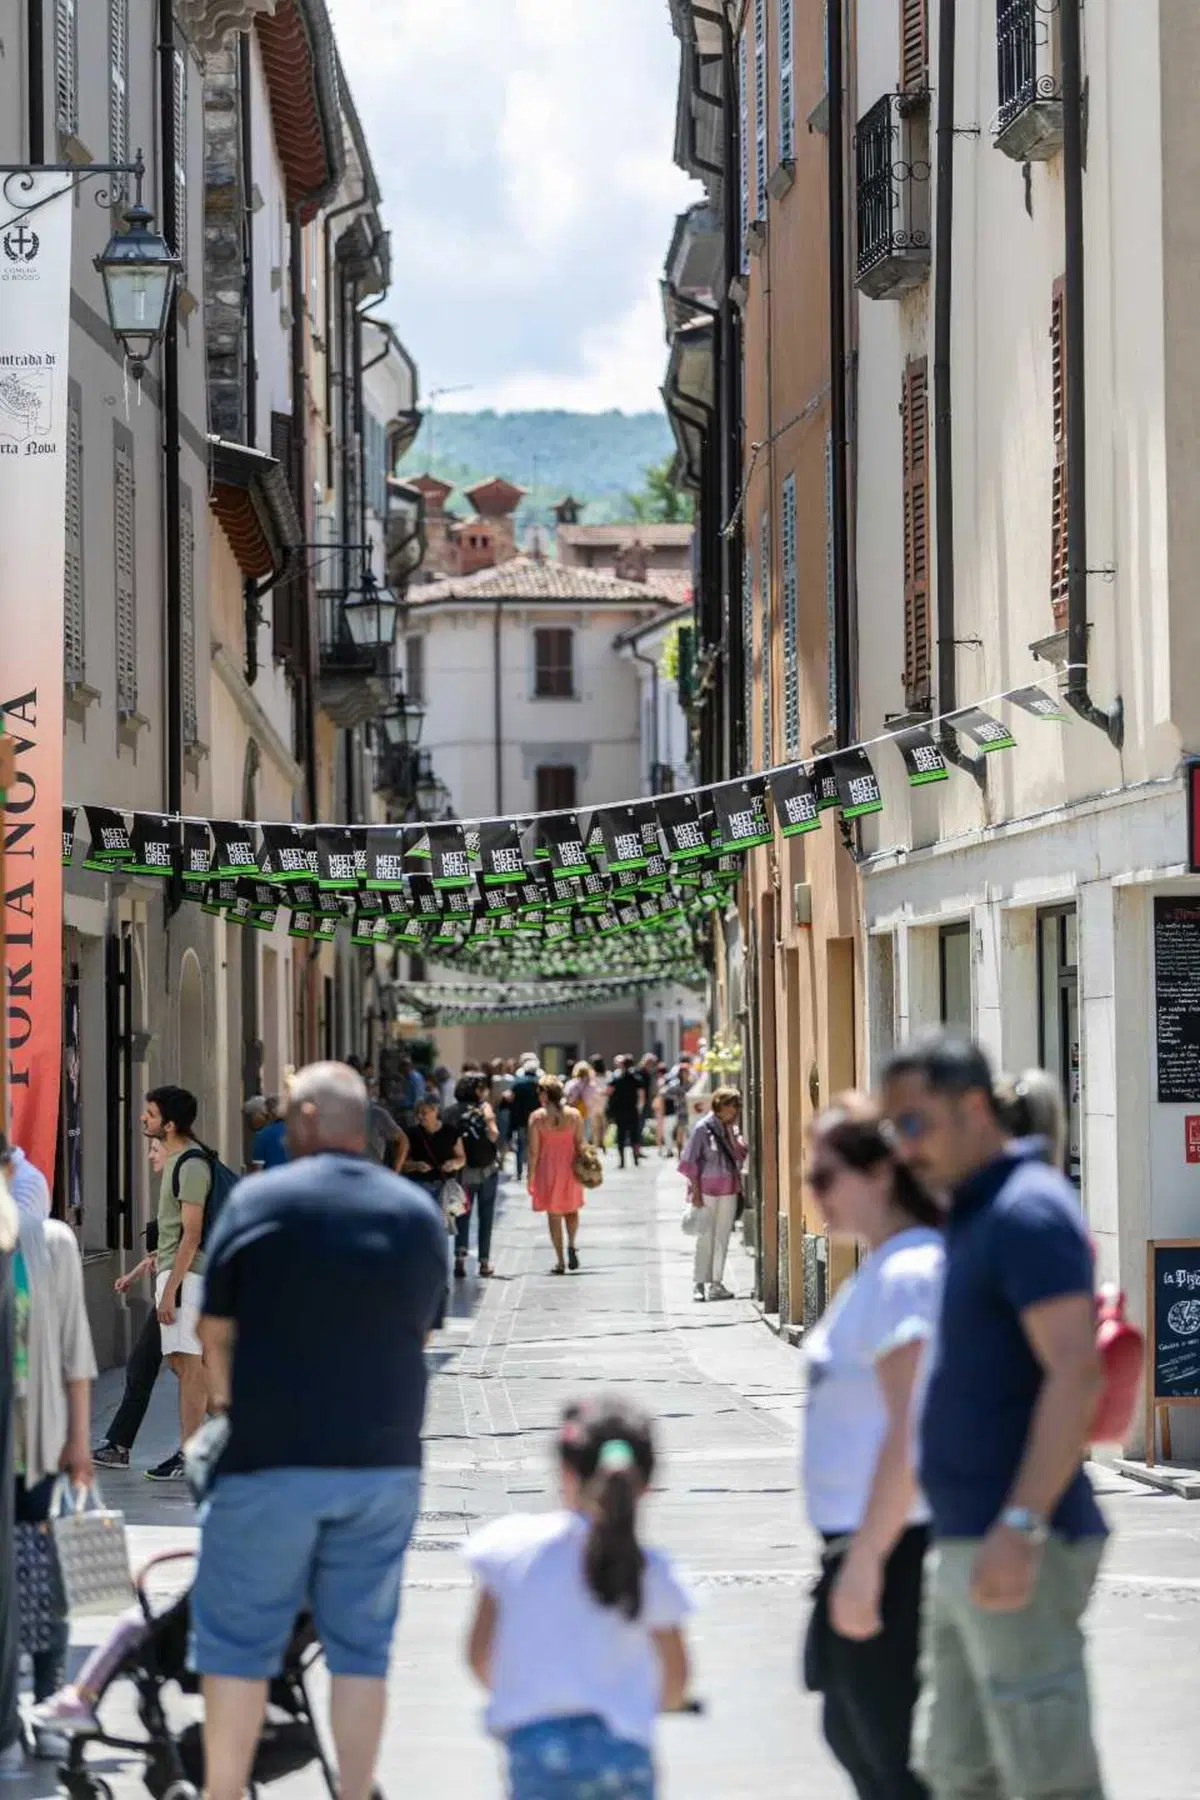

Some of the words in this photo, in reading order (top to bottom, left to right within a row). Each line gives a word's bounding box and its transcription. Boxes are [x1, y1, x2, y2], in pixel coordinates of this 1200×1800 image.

[916, 756, 944, 771] GREET
[2, 687, 37, 859] NOVA
[851, 786, 880, 804] GREET
[788, 804, 817, 823] GREET
[731, 821, 758, 839] GREET
[104, 837, 131, 849] GREET
[677, 831, 706, 849] GREET
[561, 852, 587, 866] GREET
[617, 844, 643, 860] GREET
[145, 853, 171, 866] GREET
[229, 853, 255, 866] GREET
[281, 858, 309, 871] GREET
[493, 860, 523, 873] GREET
[330, 865, 356, 879] GREET
[376, 866, 402, 879] GREET
[443, 863, 468, 877] GREET
